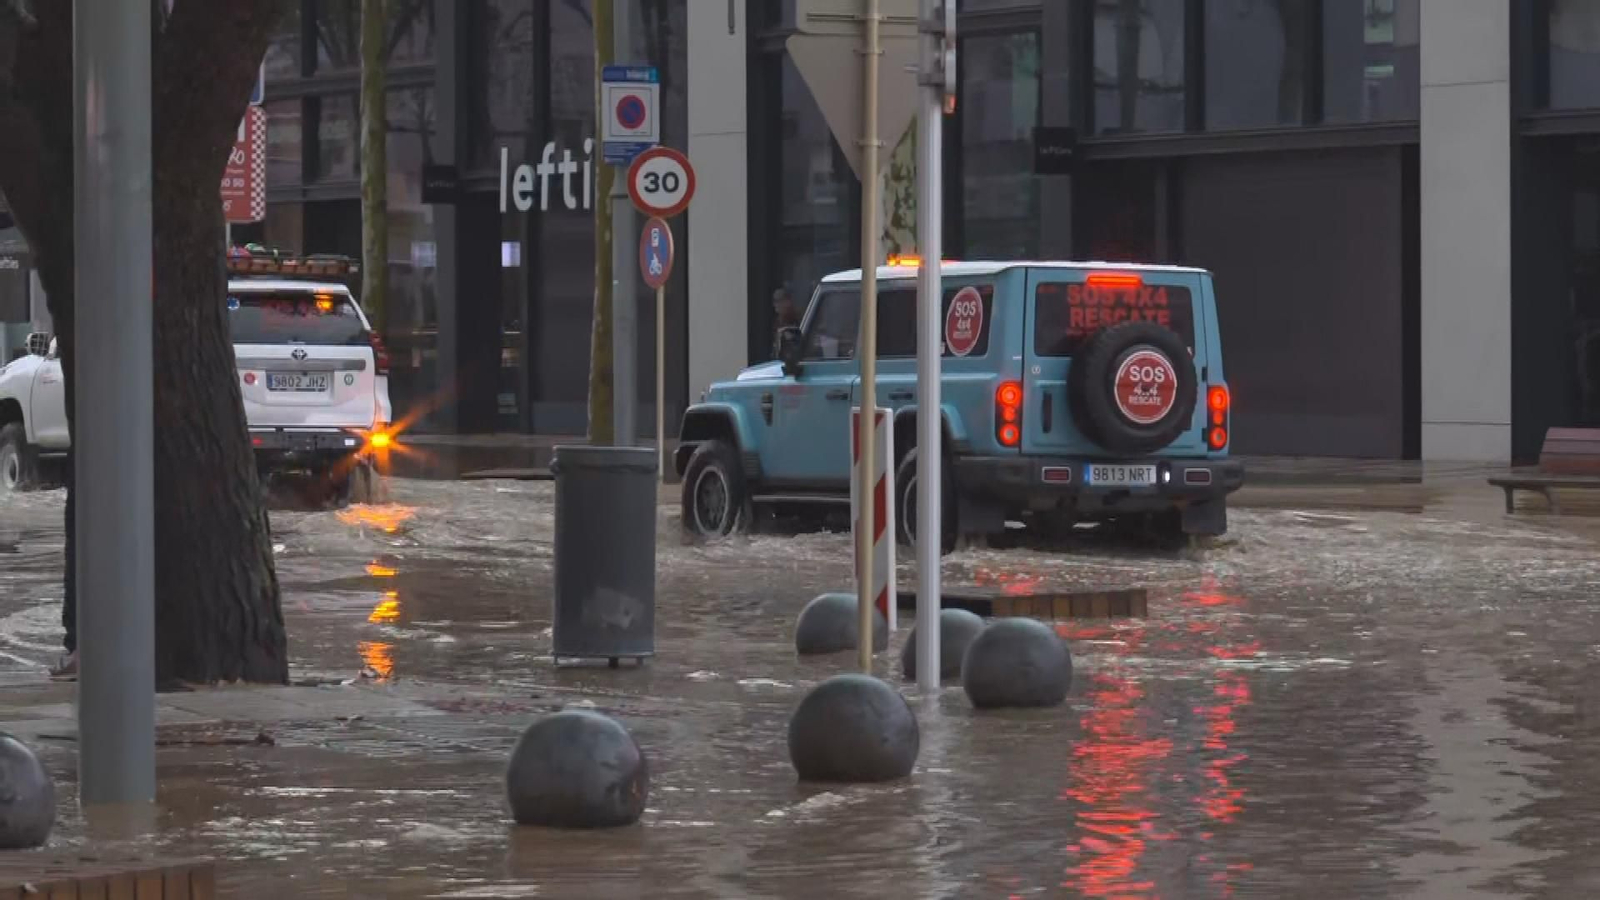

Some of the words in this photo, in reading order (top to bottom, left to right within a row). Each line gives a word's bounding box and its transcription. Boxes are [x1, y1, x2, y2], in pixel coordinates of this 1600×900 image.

[643, 171, 679, 193] 30
[1067, 284, 1115, 306] SOS
[955, 301, 977, 318] SOS
[1070, 306, 1170, 328] RESCATE
[273, 375, 302, 388] 9802
[306, 375, 326, 388] JHZ
[1129, 366, 1165, 383] SOS
[1093, 467, 1125, 481] 9813
[1129, 467, 1152, 481] NRT
